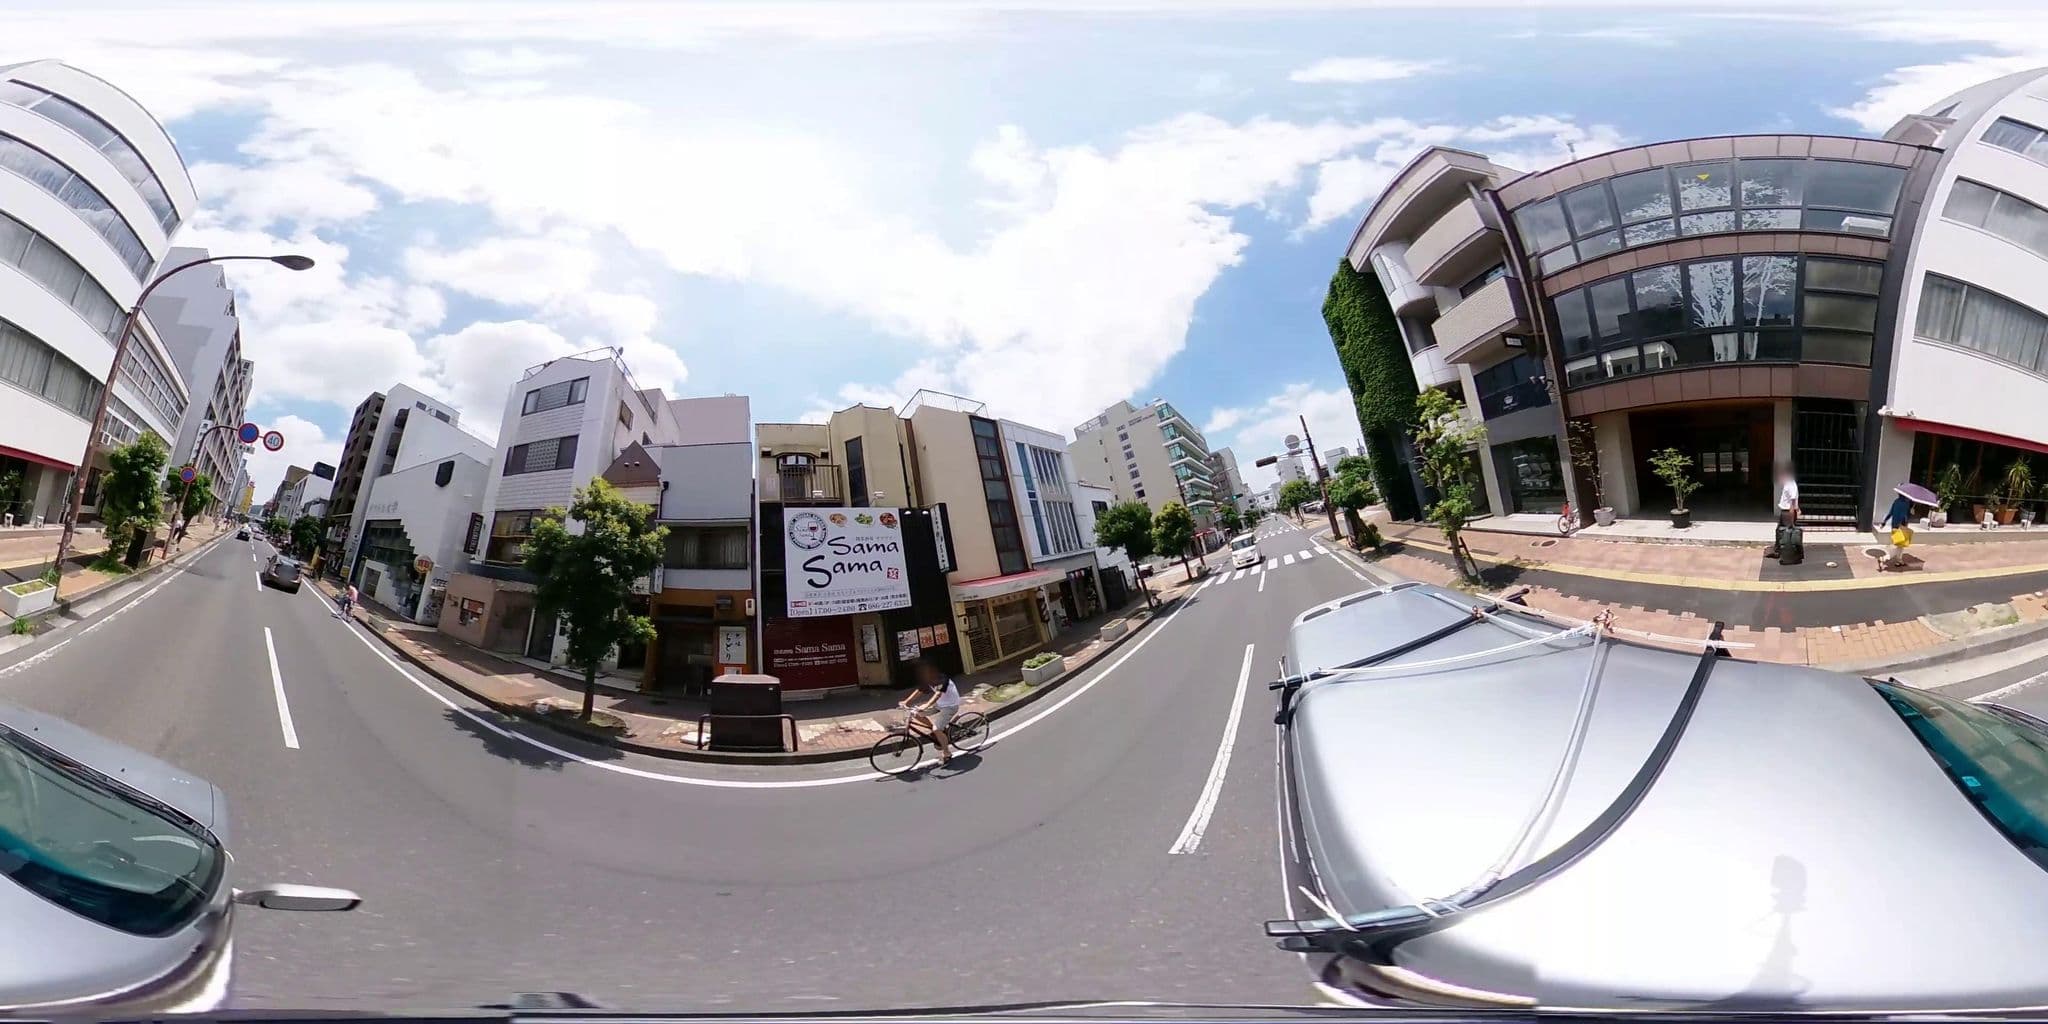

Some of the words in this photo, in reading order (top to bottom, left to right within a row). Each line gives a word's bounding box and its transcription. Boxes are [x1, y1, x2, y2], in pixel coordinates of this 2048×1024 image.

[267, 435, 279, 446] 40
[827, 536, 899, 555] Sama
[802, 554, 882, 588] Sama
[795, 644, 820, 654] Sama
[821, 643, 846, 652] Sama
